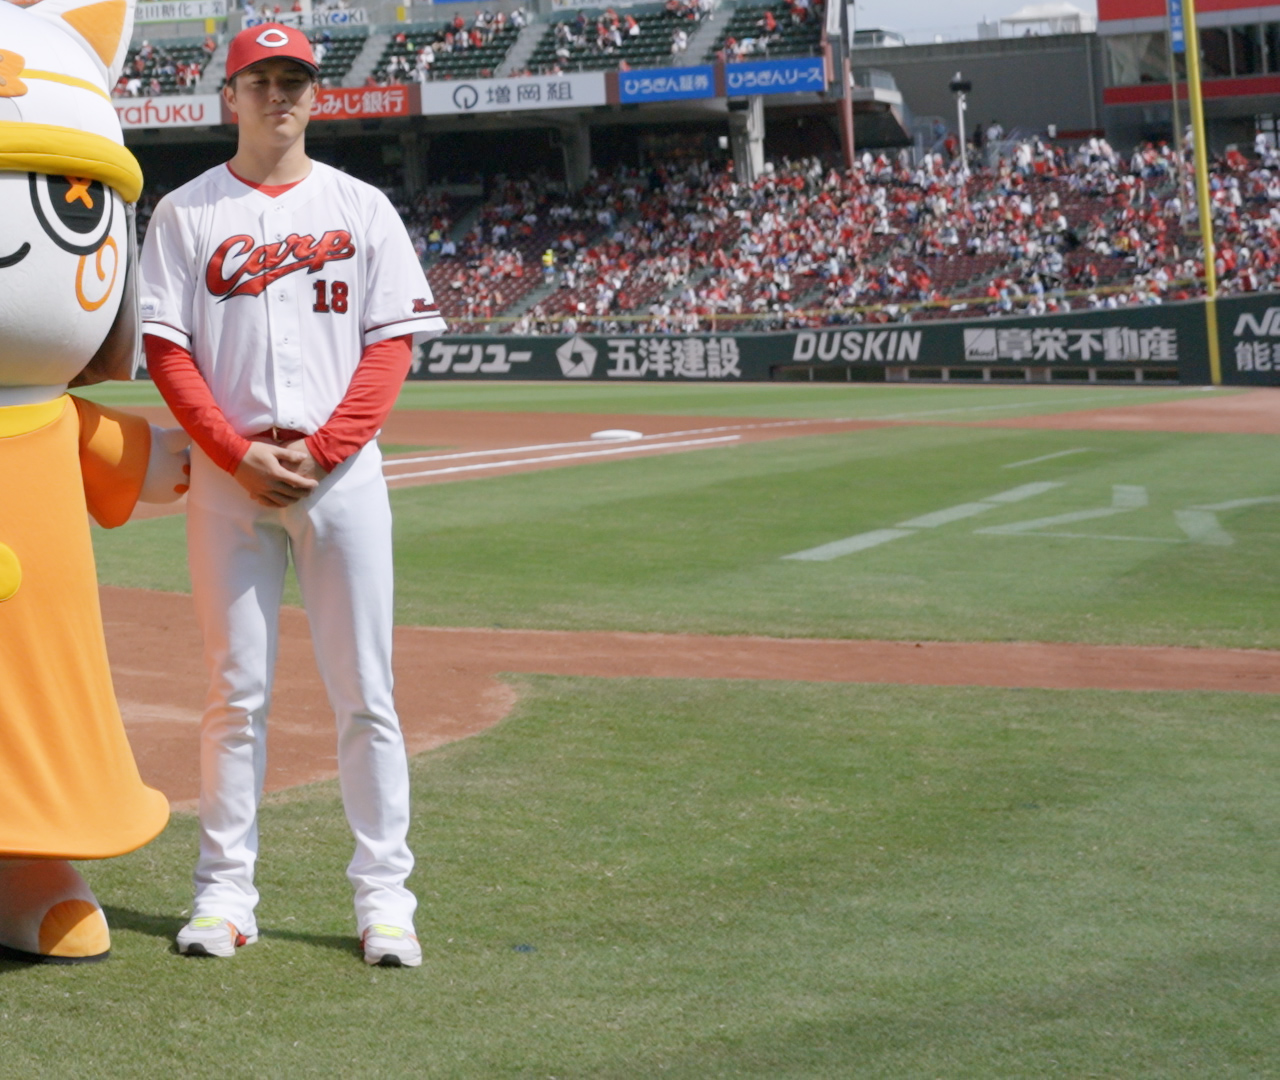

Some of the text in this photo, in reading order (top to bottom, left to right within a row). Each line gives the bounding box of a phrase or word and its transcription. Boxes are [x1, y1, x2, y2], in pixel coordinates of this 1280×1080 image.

[485, 81, 573, 105] 増岡組
[624, 74, 710, 95] ひろぎん証券
[727, 67, 823, 88] ひろぎんリース
[206, 229, 356, 303] Carp
[313, 279, 348, 314] 18
[428, 341, 532, 374] ケンユー
[607, 337, 741, 378] 五洋建設
[793, 330, 922, 362] DUSKIN
